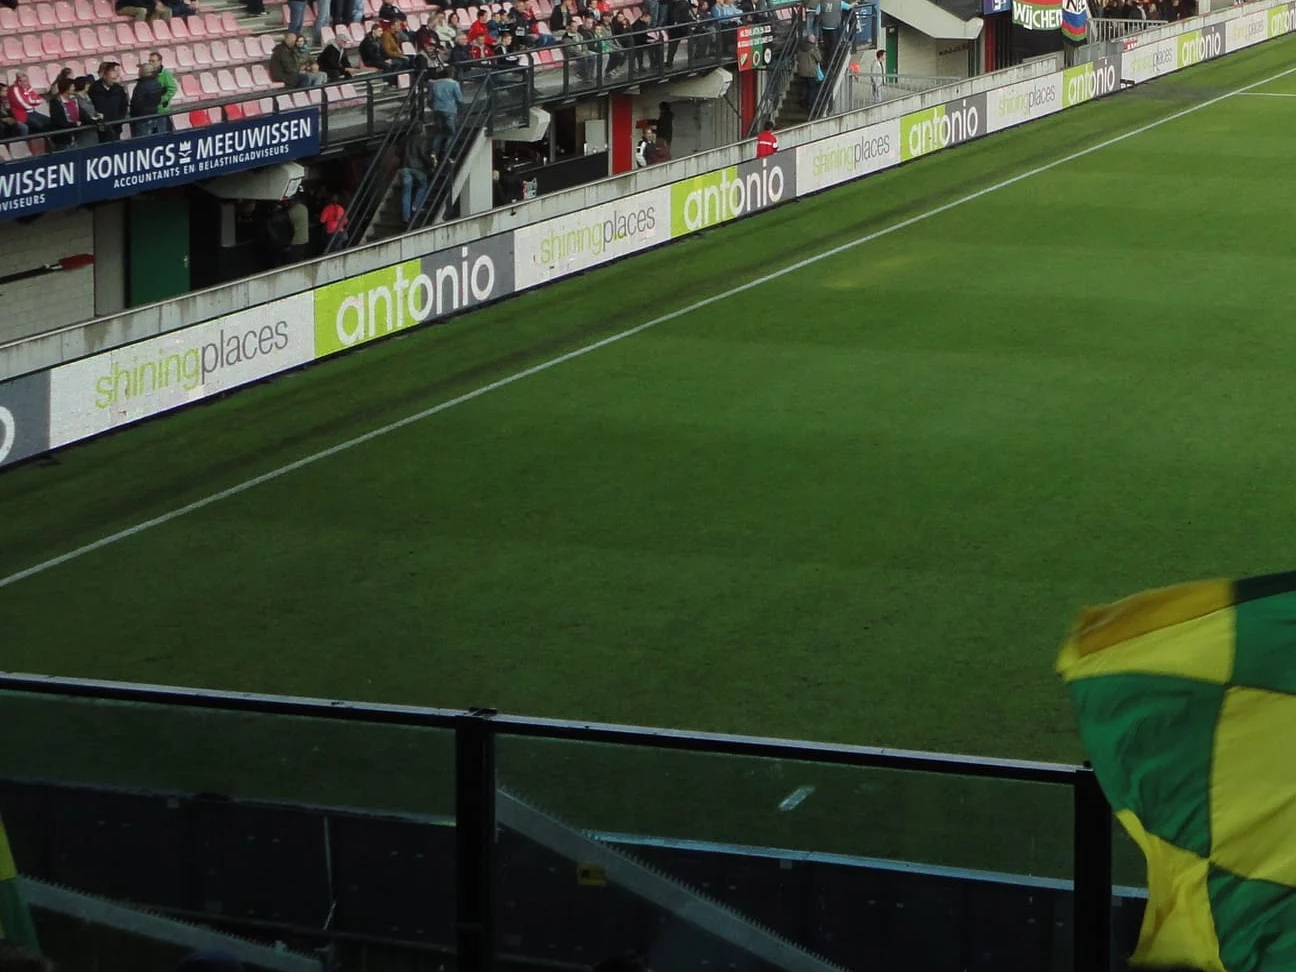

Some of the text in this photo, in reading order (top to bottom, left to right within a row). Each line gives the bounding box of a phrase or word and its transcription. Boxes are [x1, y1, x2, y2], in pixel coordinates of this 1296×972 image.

[1182, 26, 1221, 67] antonio
[1067, 54, 1116, 103] antonio
[86, 115, 312, 181] KONINGS MEEUWISSEN
[812, 133, 890, 179] shiningplaces
[908, 100, 978, 158] antonio
[113, 143, 290, 189] ACCOUNTANTS EN BELASTINGADVISEURS
[683, 159, 784, 232] antonio
[540, 204, 656, 265] shiningplaces
[336, 246, 495, 346] antonio
[95, 319, 289, 409] shiningplaces
